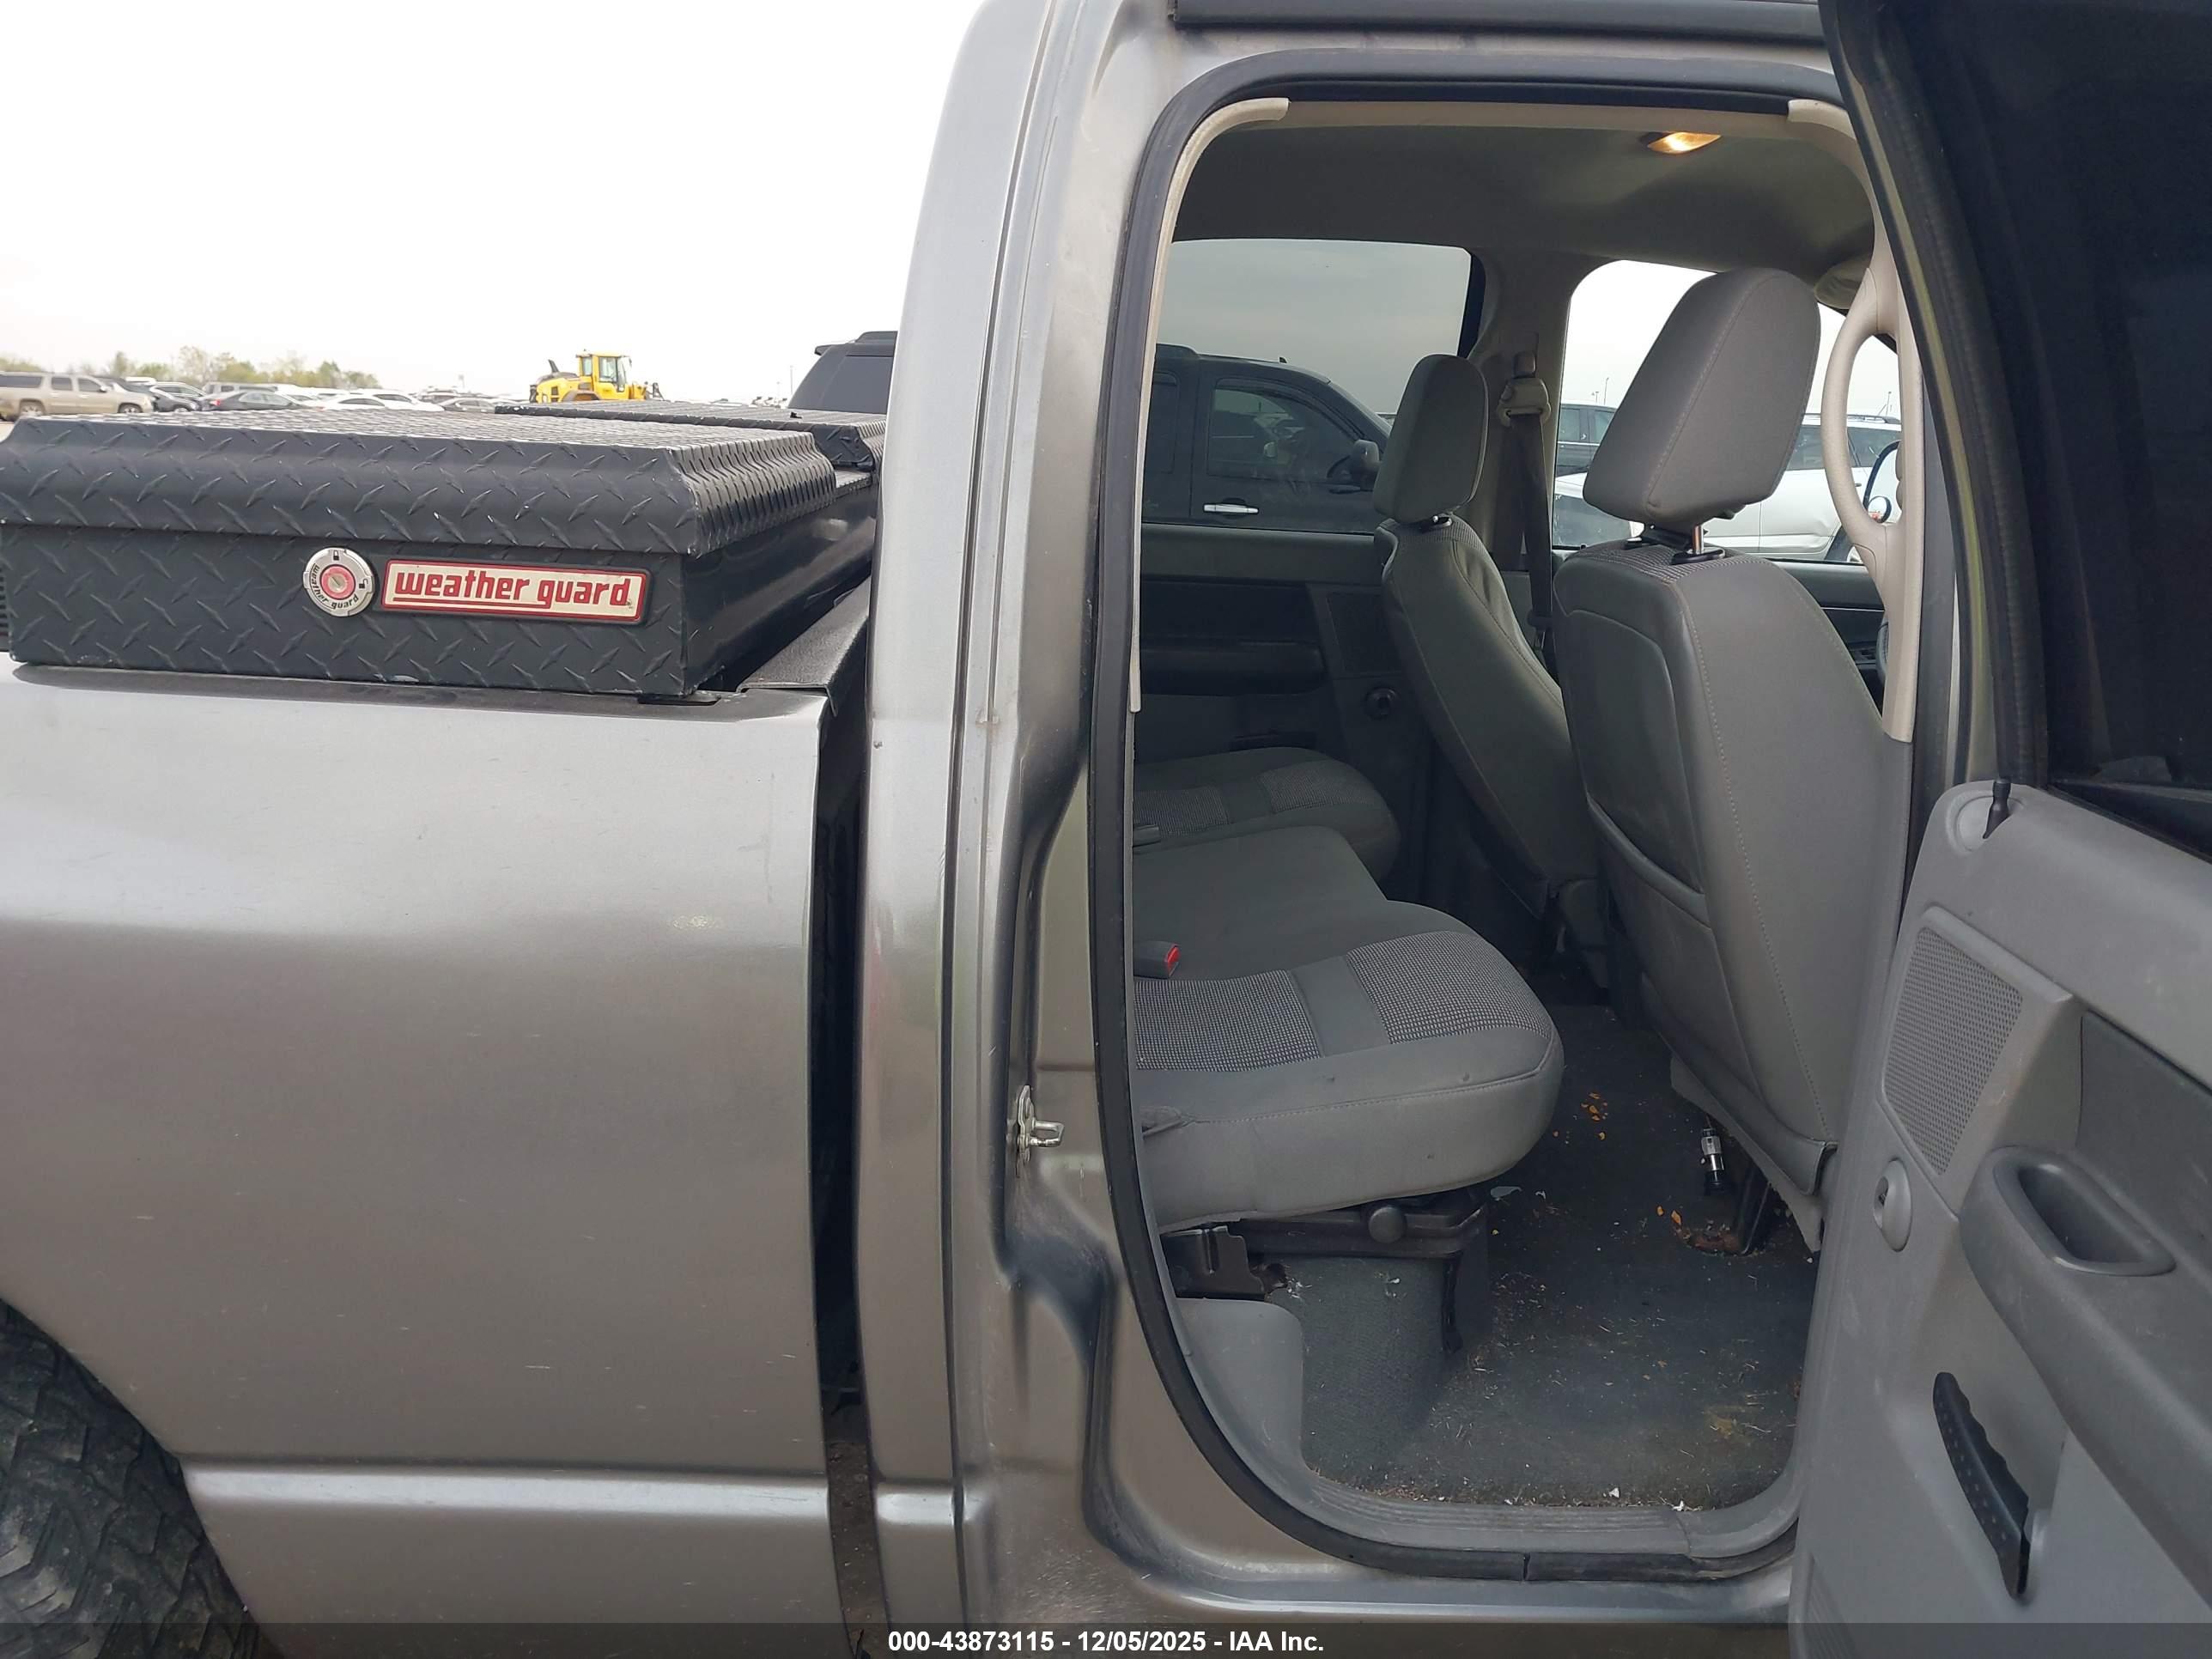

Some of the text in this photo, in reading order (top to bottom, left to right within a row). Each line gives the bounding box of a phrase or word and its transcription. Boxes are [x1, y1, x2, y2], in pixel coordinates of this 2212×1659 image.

[310, 563, 359, 610] weather guard
[394, 570, 631, 610] weather guard
